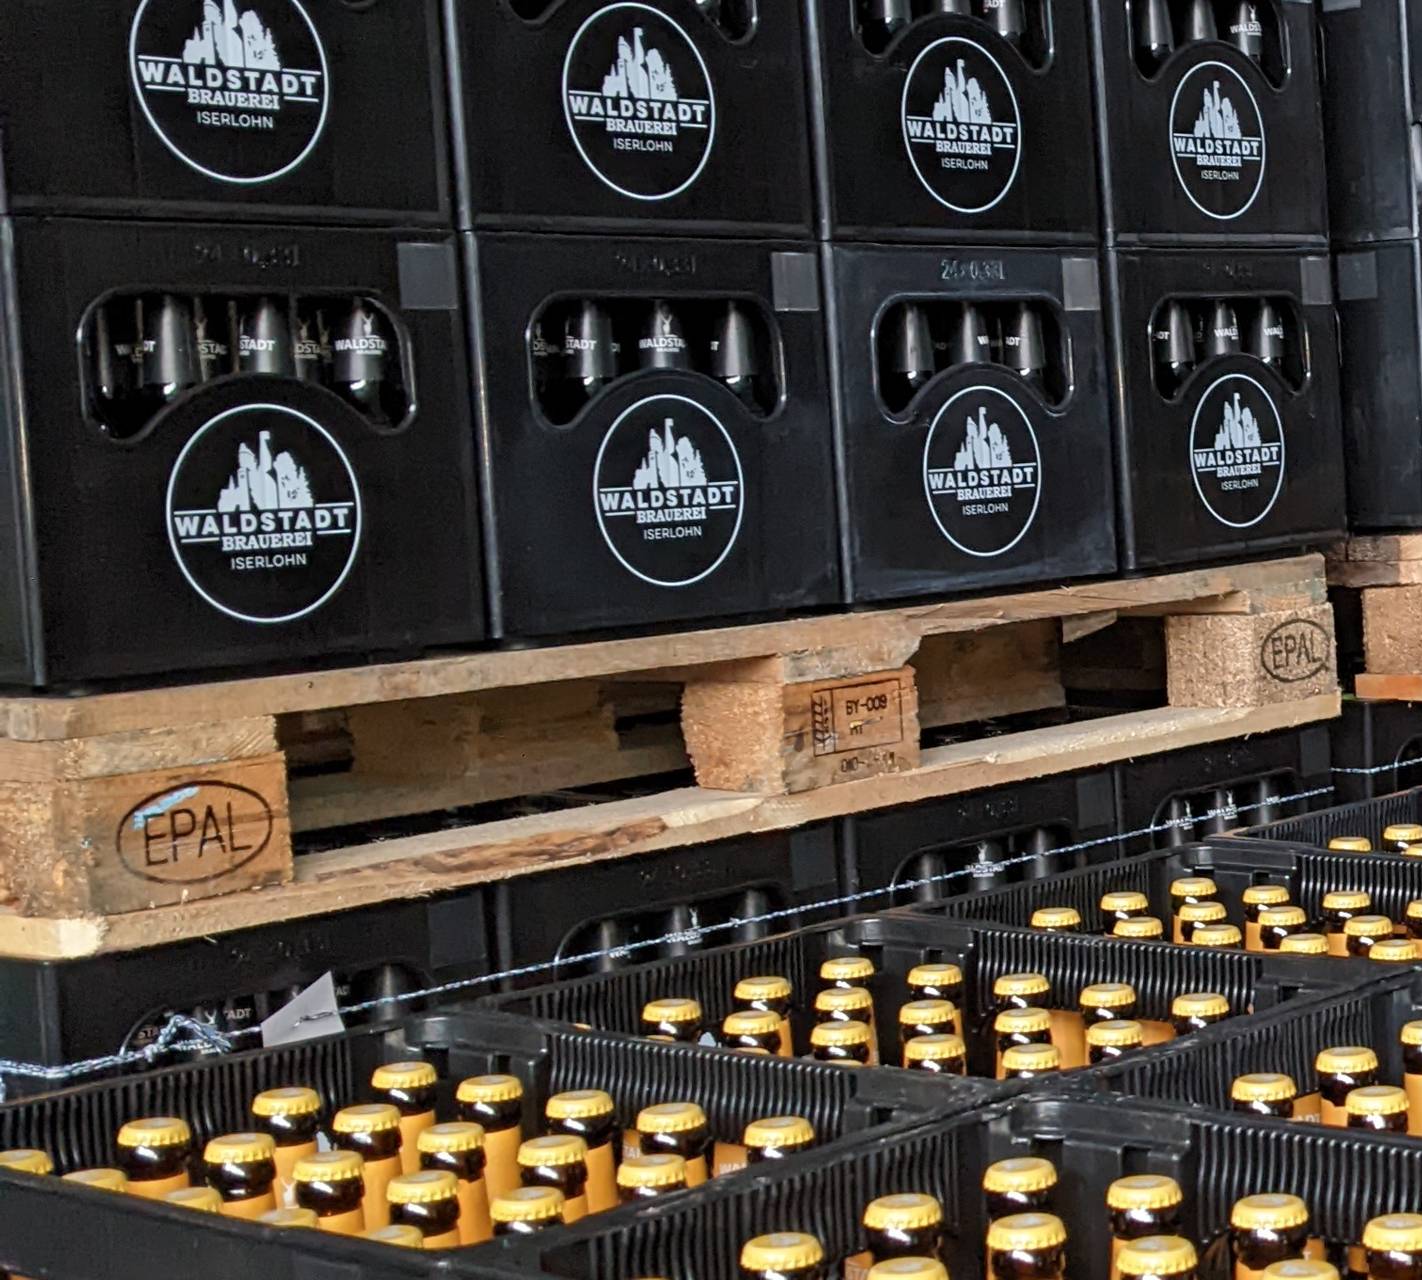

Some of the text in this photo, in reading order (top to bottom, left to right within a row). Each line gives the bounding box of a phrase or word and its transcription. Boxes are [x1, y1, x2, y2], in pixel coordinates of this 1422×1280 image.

[139, 61, 316, 95] WALDSTADT
[187, 88, 280, 109] BRAUEREI
[569, 95, 705, 122] WALDSTADT
[197, 111, 273, 129] ISERLOHN
[606, 117, 677, 135] BRAUEREI
[907, 120, 1013, 143] WALDSTADT
[613, 137, 673, 152] ISERLOHN
[936, 140, 992, 155] BRAUEREI
[1174, 137, 1259, 155] WALDSTADT
[941, 157, 988, 170] ISERLOHN
[1197, 154, 1242, 167] BRAUEREI
[1201, 170, 1239, 180] ISERLOHN
[1194, 447, 1278, 467] WALDSTADT
[928, 467, 1033, 489] WALDSTADT
[1217, 463, 1262, 477] BRAUEREI
[957, 486, 1012, 501] BRAUEREI
[1221, 479, 1259, 491] ISERLOHN
[601, 486, 734, 511] WALDSTADT
[636, 507, 707, 524] BRAUEREI
[962, 503, 1008, 516] ISERLOHN
[174, 508, 349, 537] WALDSTADT
[222, 532, 313, 551] BRAUEREI
[644, 525, 702, 540] ISERLOHN
[231, 553, 306, 570] ISERLOHN
[1270, 629, 1322, 669] EPAL
[846, 694, 887, 715] BY-009
[143, 801, 252, 866] EPAL
